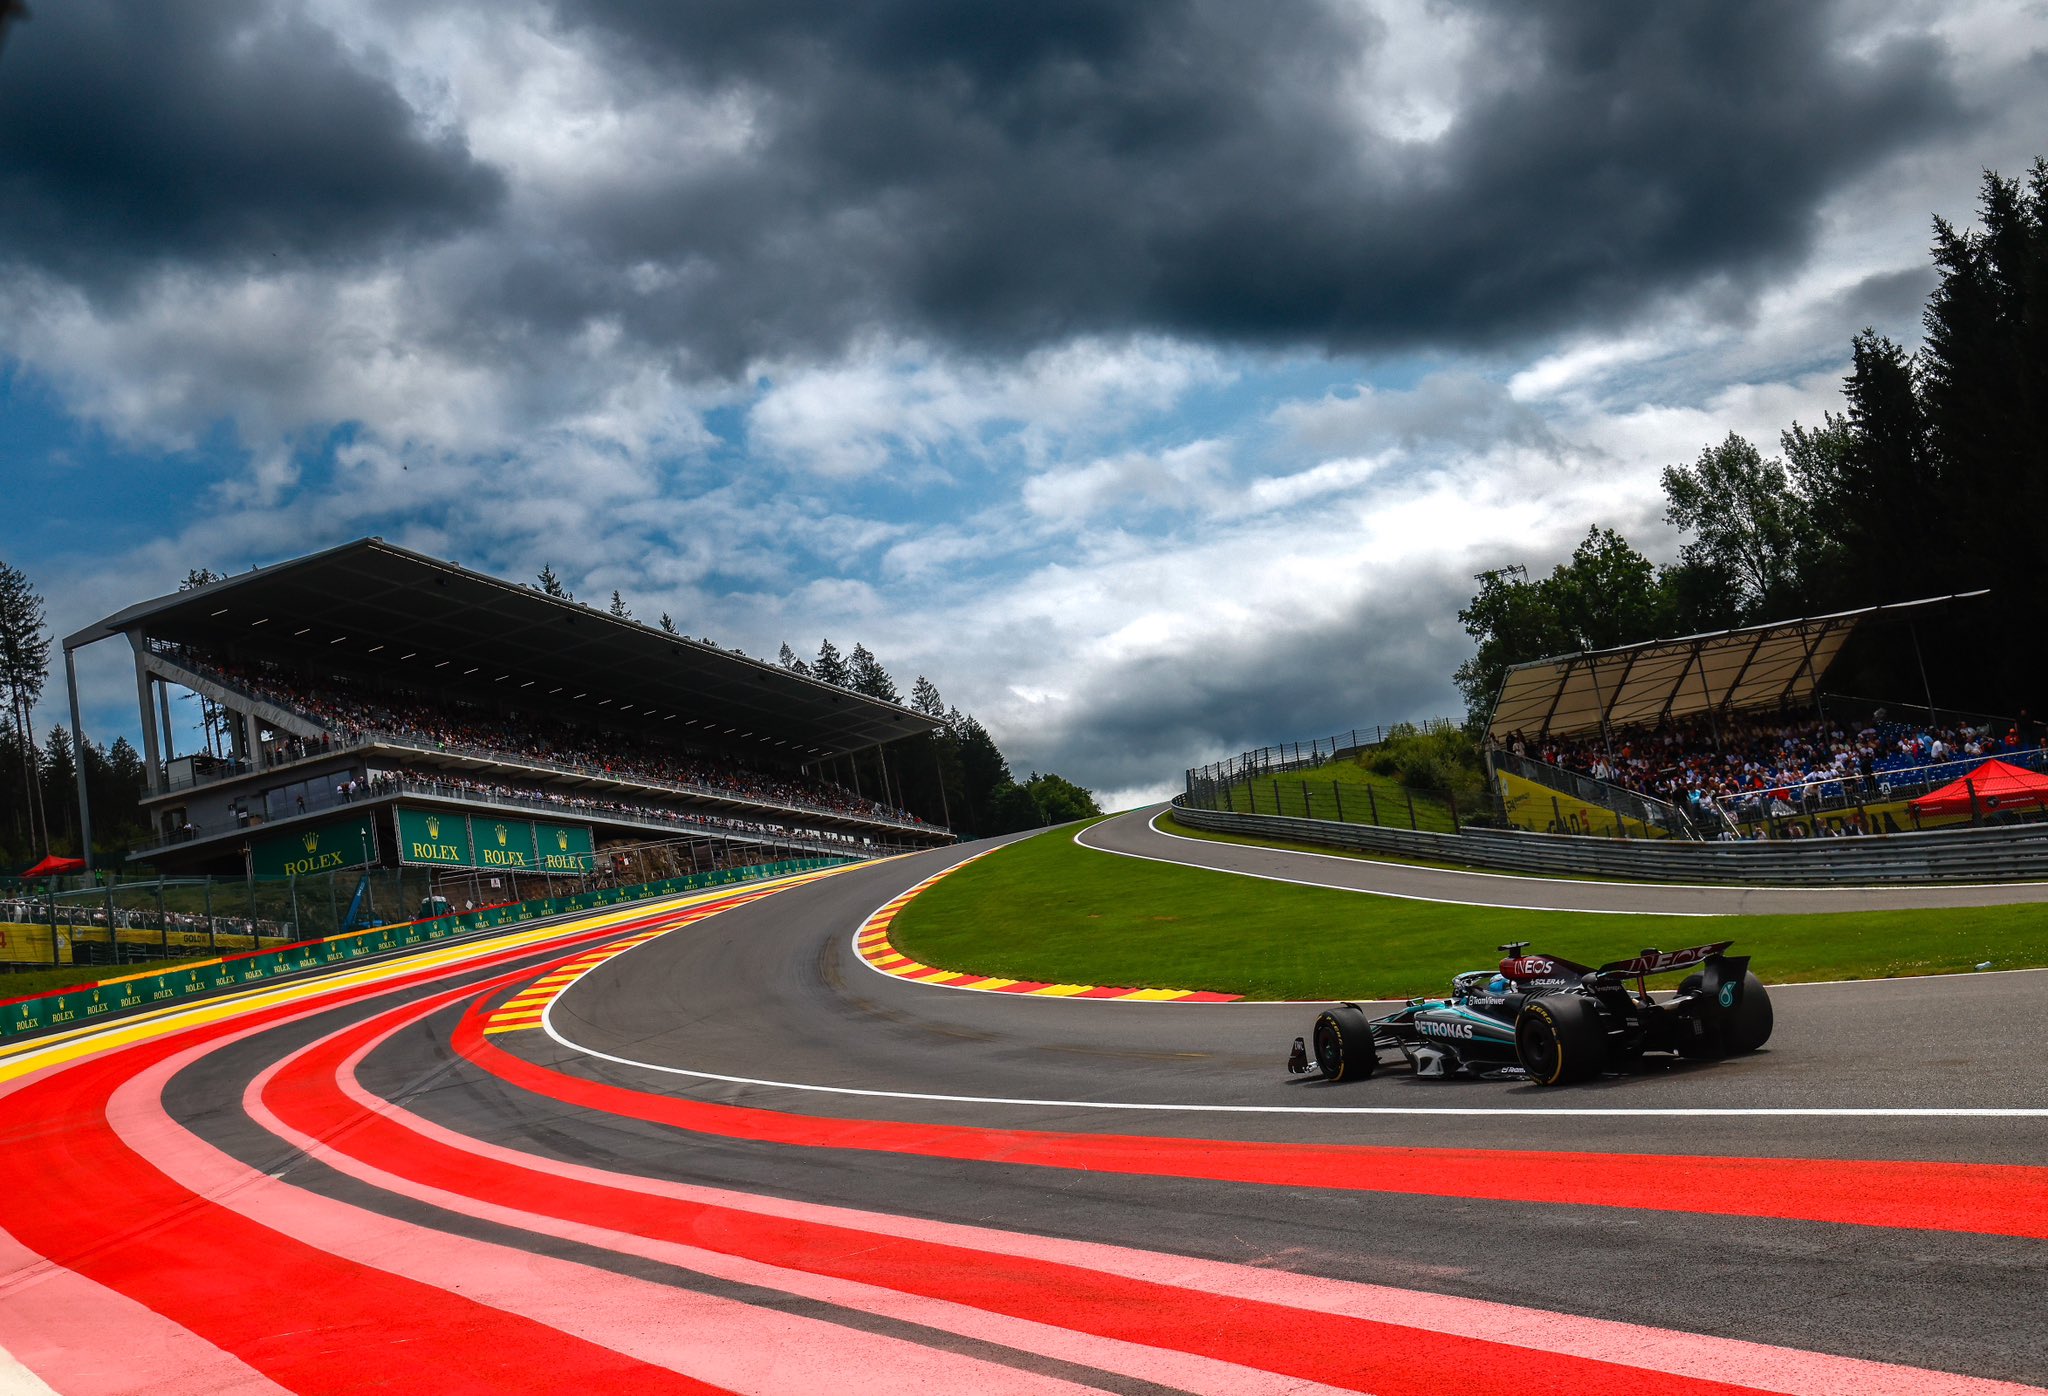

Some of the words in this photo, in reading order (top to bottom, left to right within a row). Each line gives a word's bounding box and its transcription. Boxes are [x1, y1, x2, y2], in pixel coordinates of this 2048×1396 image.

[1883, 784, 1891, 793] A
[412, 843, 459, 861] ROLEX
[483, 849, 527, 866] ROLEX
[284, 851, 343, 876] ROLEX
[546, 854, 585, 869] ROLEX
[518, 912, 532, 920] ROLEX
[540, 908, 554, 916] ROLEX
[475, 921, 490, 929] ROLEX
[497, 916, 513, 924] ROLEX
[429, 930, 445, 939] ROLEX
[452, 925, 466, 934] ROLEX
[378, 940, 397, 950] ROLEX
[405, 935, 421, 944] ROLEX
[327, 951, 344, 962] ROLEX
[352, 946, 370, 956] ROLEX
[300, 958, 317, 968] ROLEX
[1629, 946, 1712, 973] INEOS
[274, 963, 290, 974] ROLEX
[1514, 960, 1554, 974] INEOS
[245, 969, 264, 980] ROLEX
[216, 975, 235, 986] ROLEX
[185, 982, 206, 993] ROLEX
[154, 988, 174, 1000] ROLEX
[120, 995, 142, 1008] ROLEX
[1473, 996, 1505, 1006] TeamViewer
[87, 1002, 108, 1015] ROLEX
[1530, 1004, 1552, 1024] ZERO
[52, 1010, 74, 1023] ROLEX
[16, 1018, 38, 1031] ROLEX
[1415, 1020, 1472, 1038] PETRONAS
